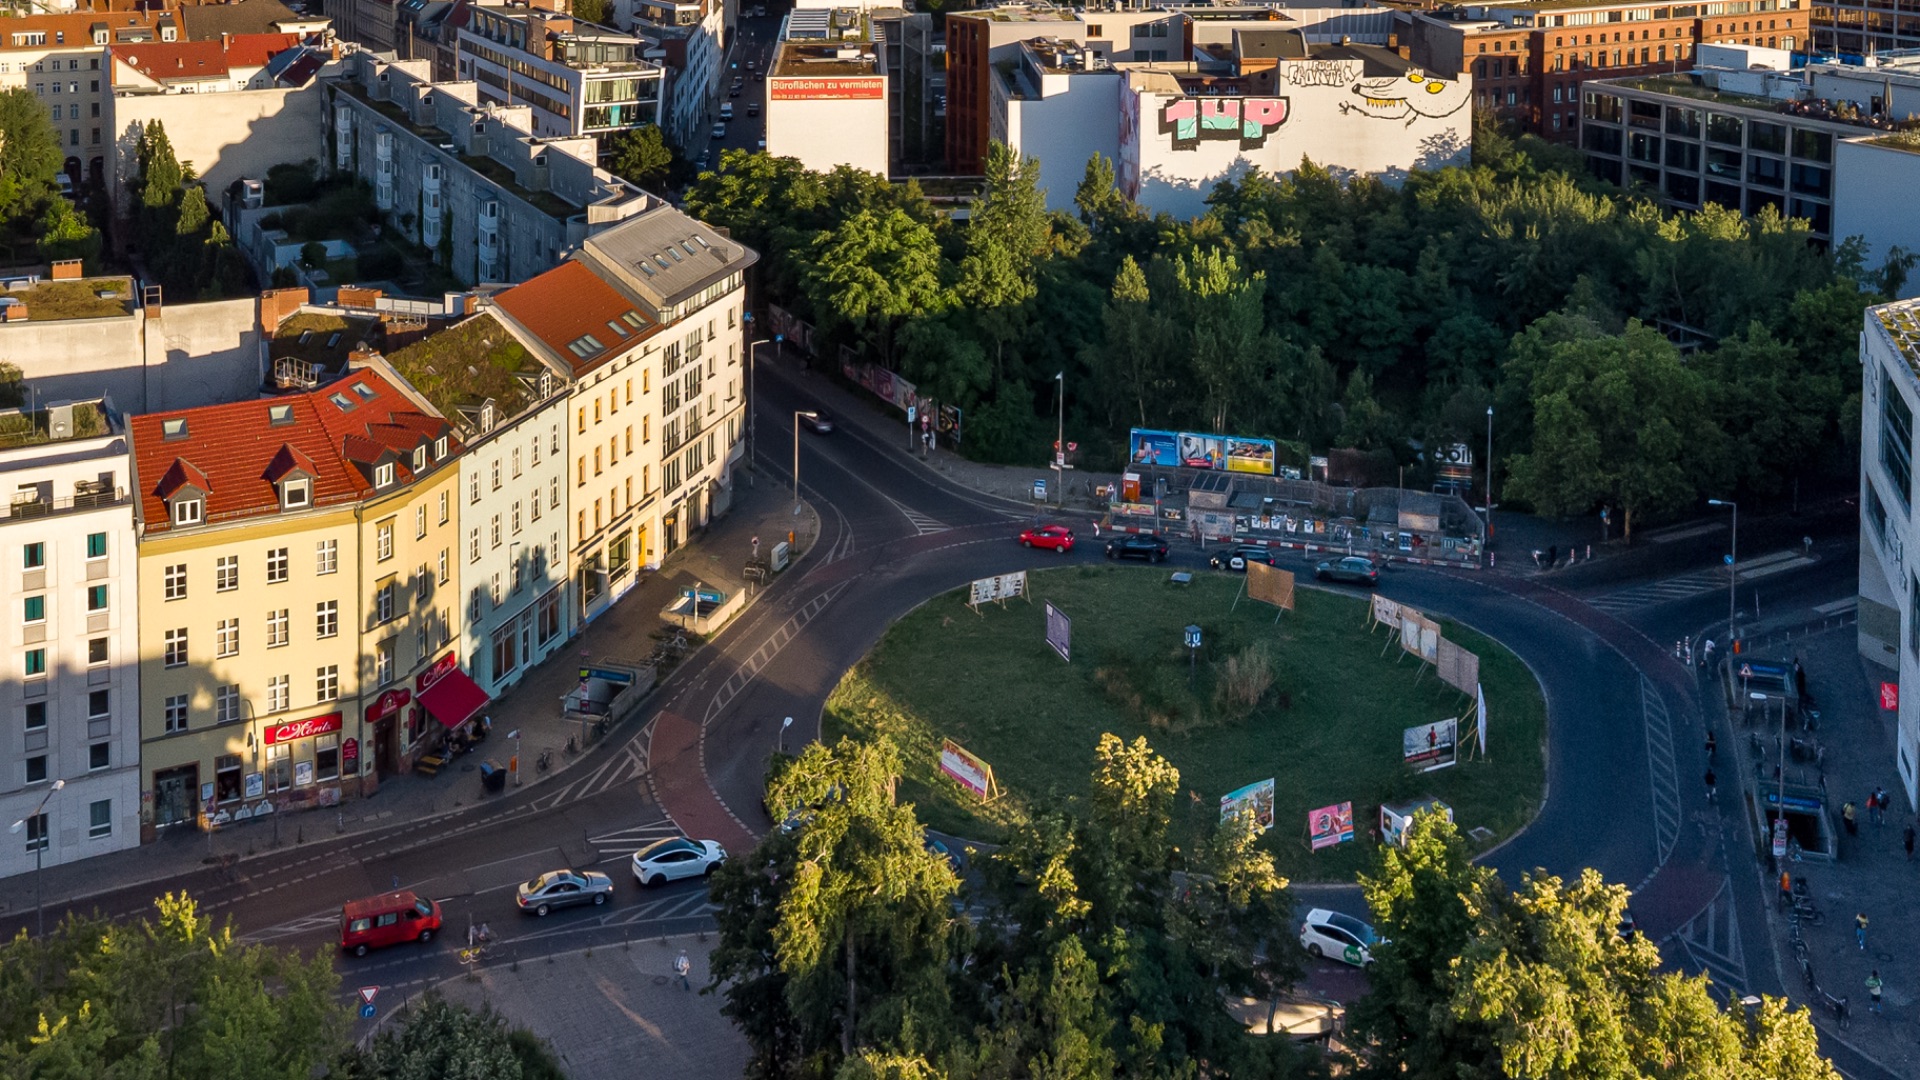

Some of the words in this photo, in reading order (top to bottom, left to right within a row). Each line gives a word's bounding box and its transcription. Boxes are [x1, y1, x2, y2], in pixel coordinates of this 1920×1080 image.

[772, 80, 825, 90] Büroflächen
[840, 80, 883, 89] vermieten
[1158, 97, 1290, 152] 1UP
[1193, 633, 1200, 643] U
[276, 720, 333, 741] Moritz
